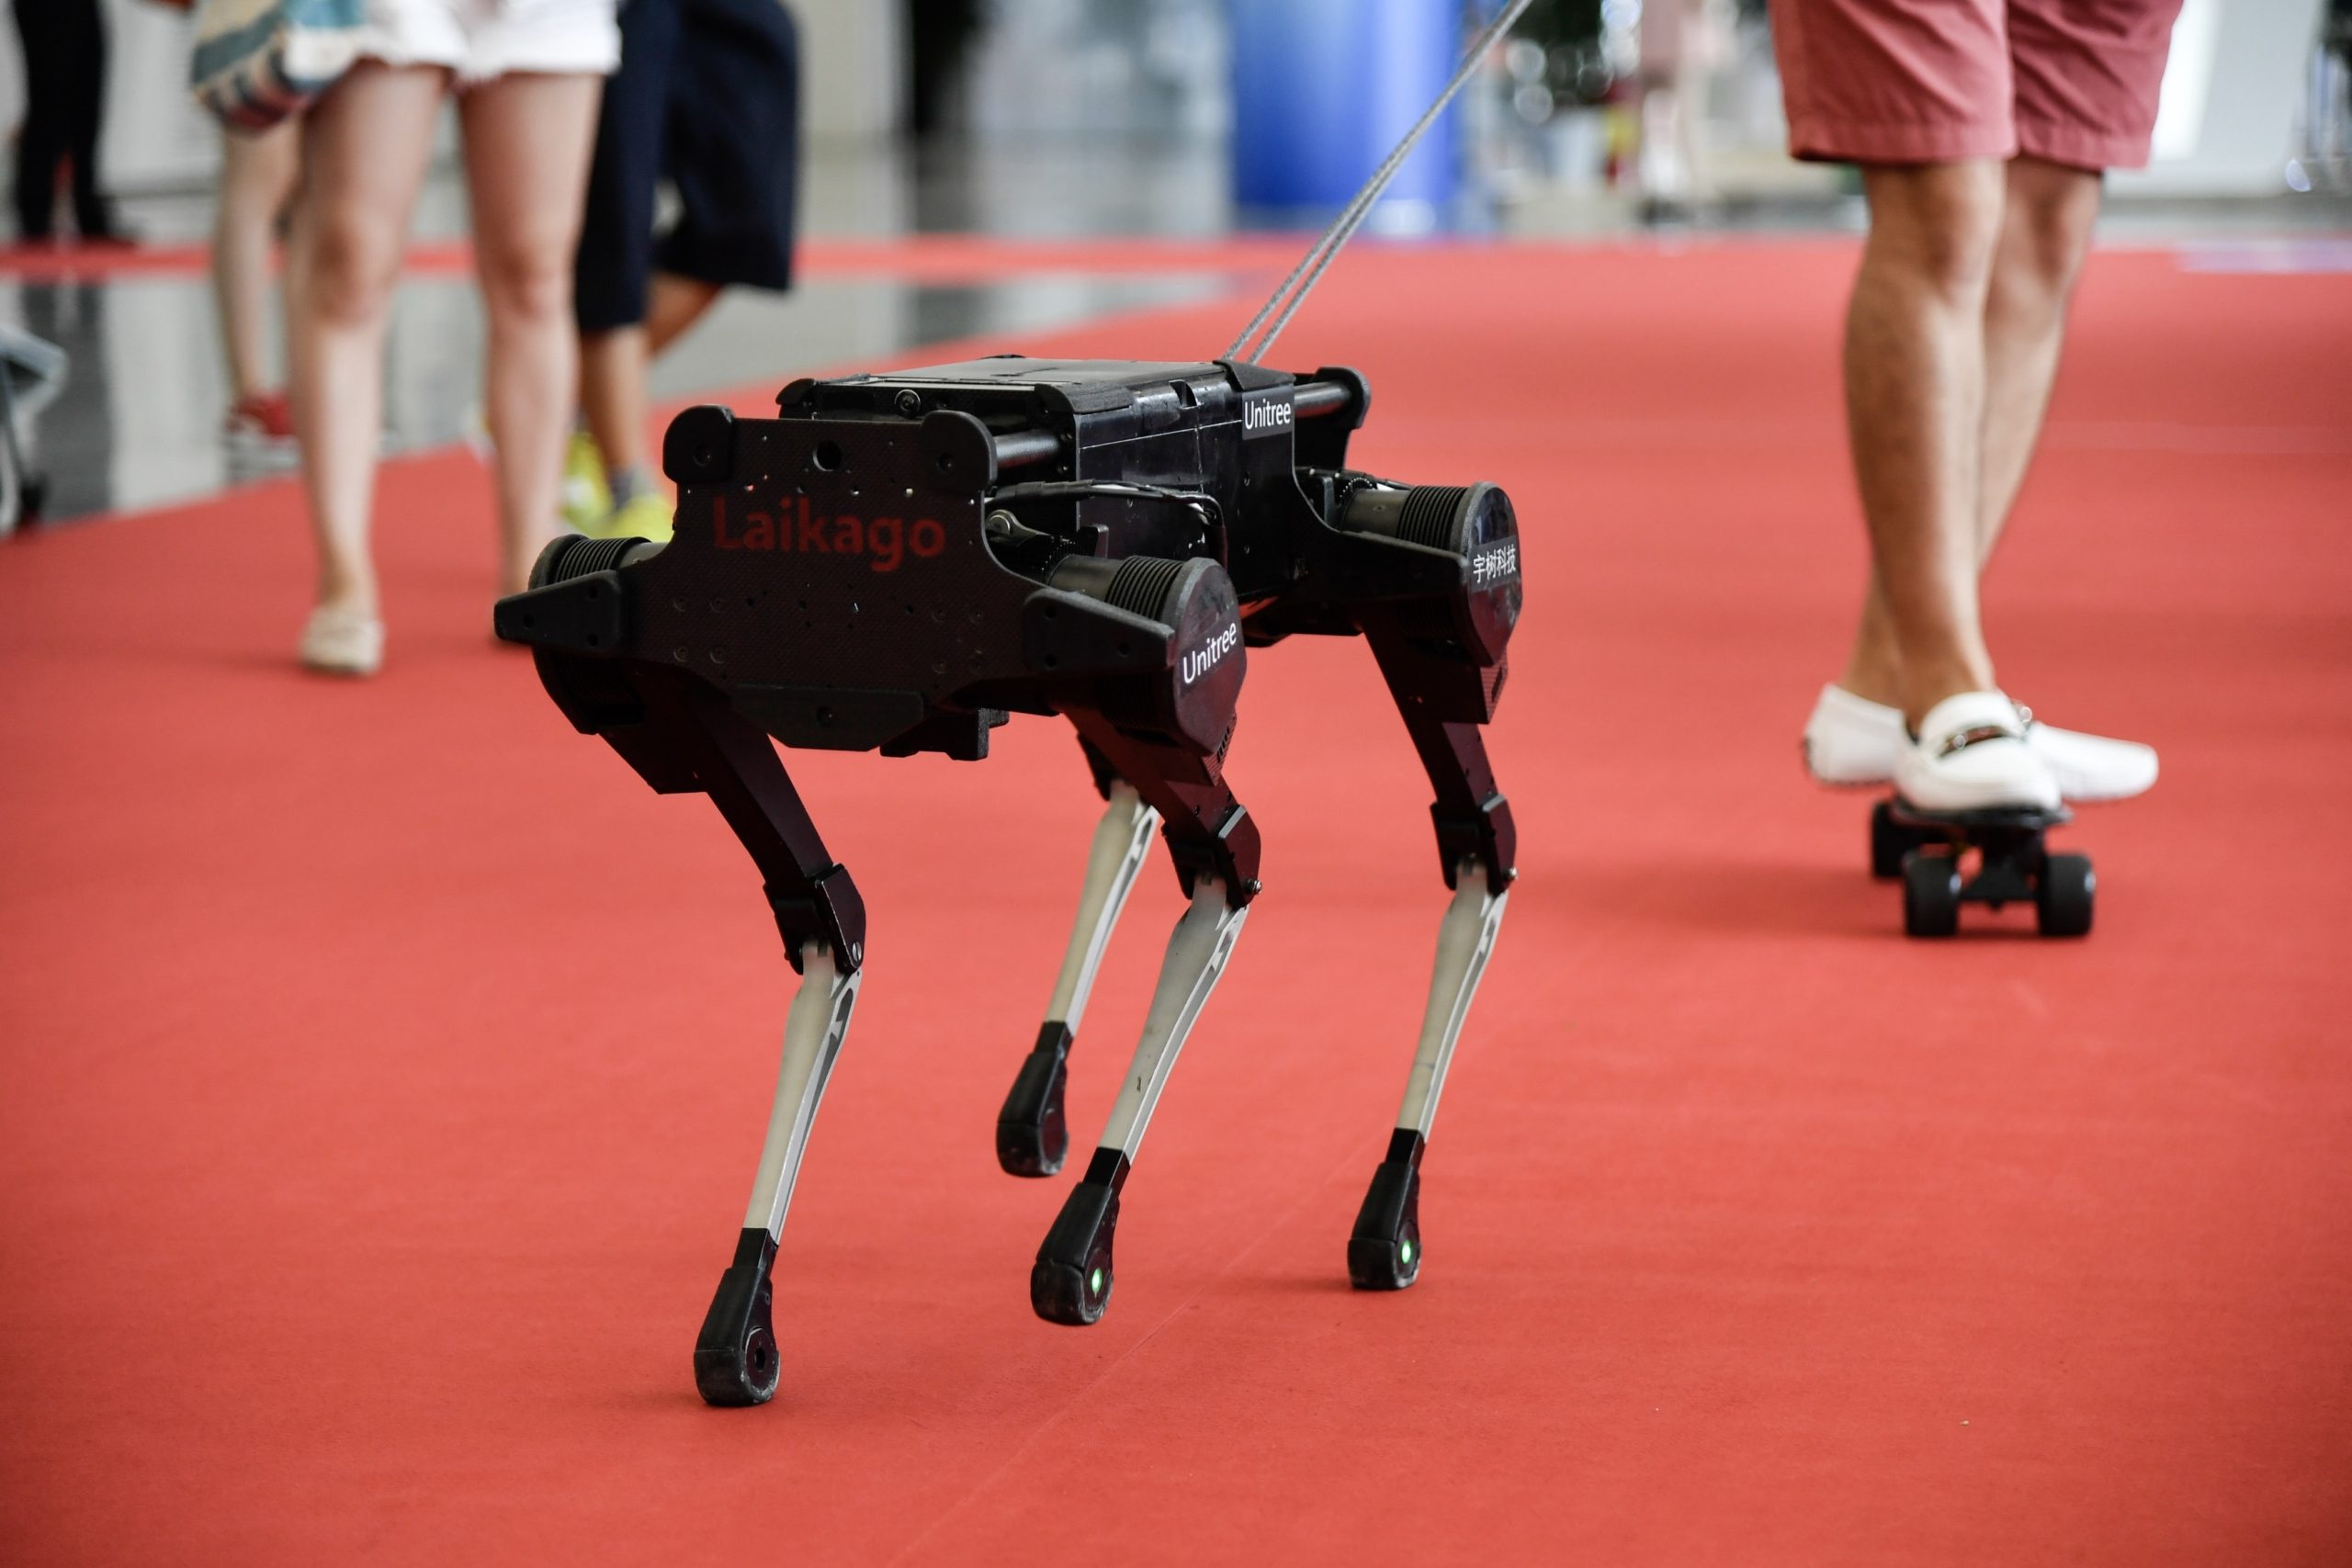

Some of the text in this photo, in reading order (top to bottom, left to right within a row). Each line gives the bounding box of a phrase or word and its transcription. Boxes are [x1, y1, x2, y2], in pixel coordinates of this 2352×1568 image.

[1245, 398, 1292, 430] Unitree
[714, 496, 945, 572] Laikago
[1473, 544, 1516, 584] 宇树科技
[1182, 622, 1237, 684] Unitree
